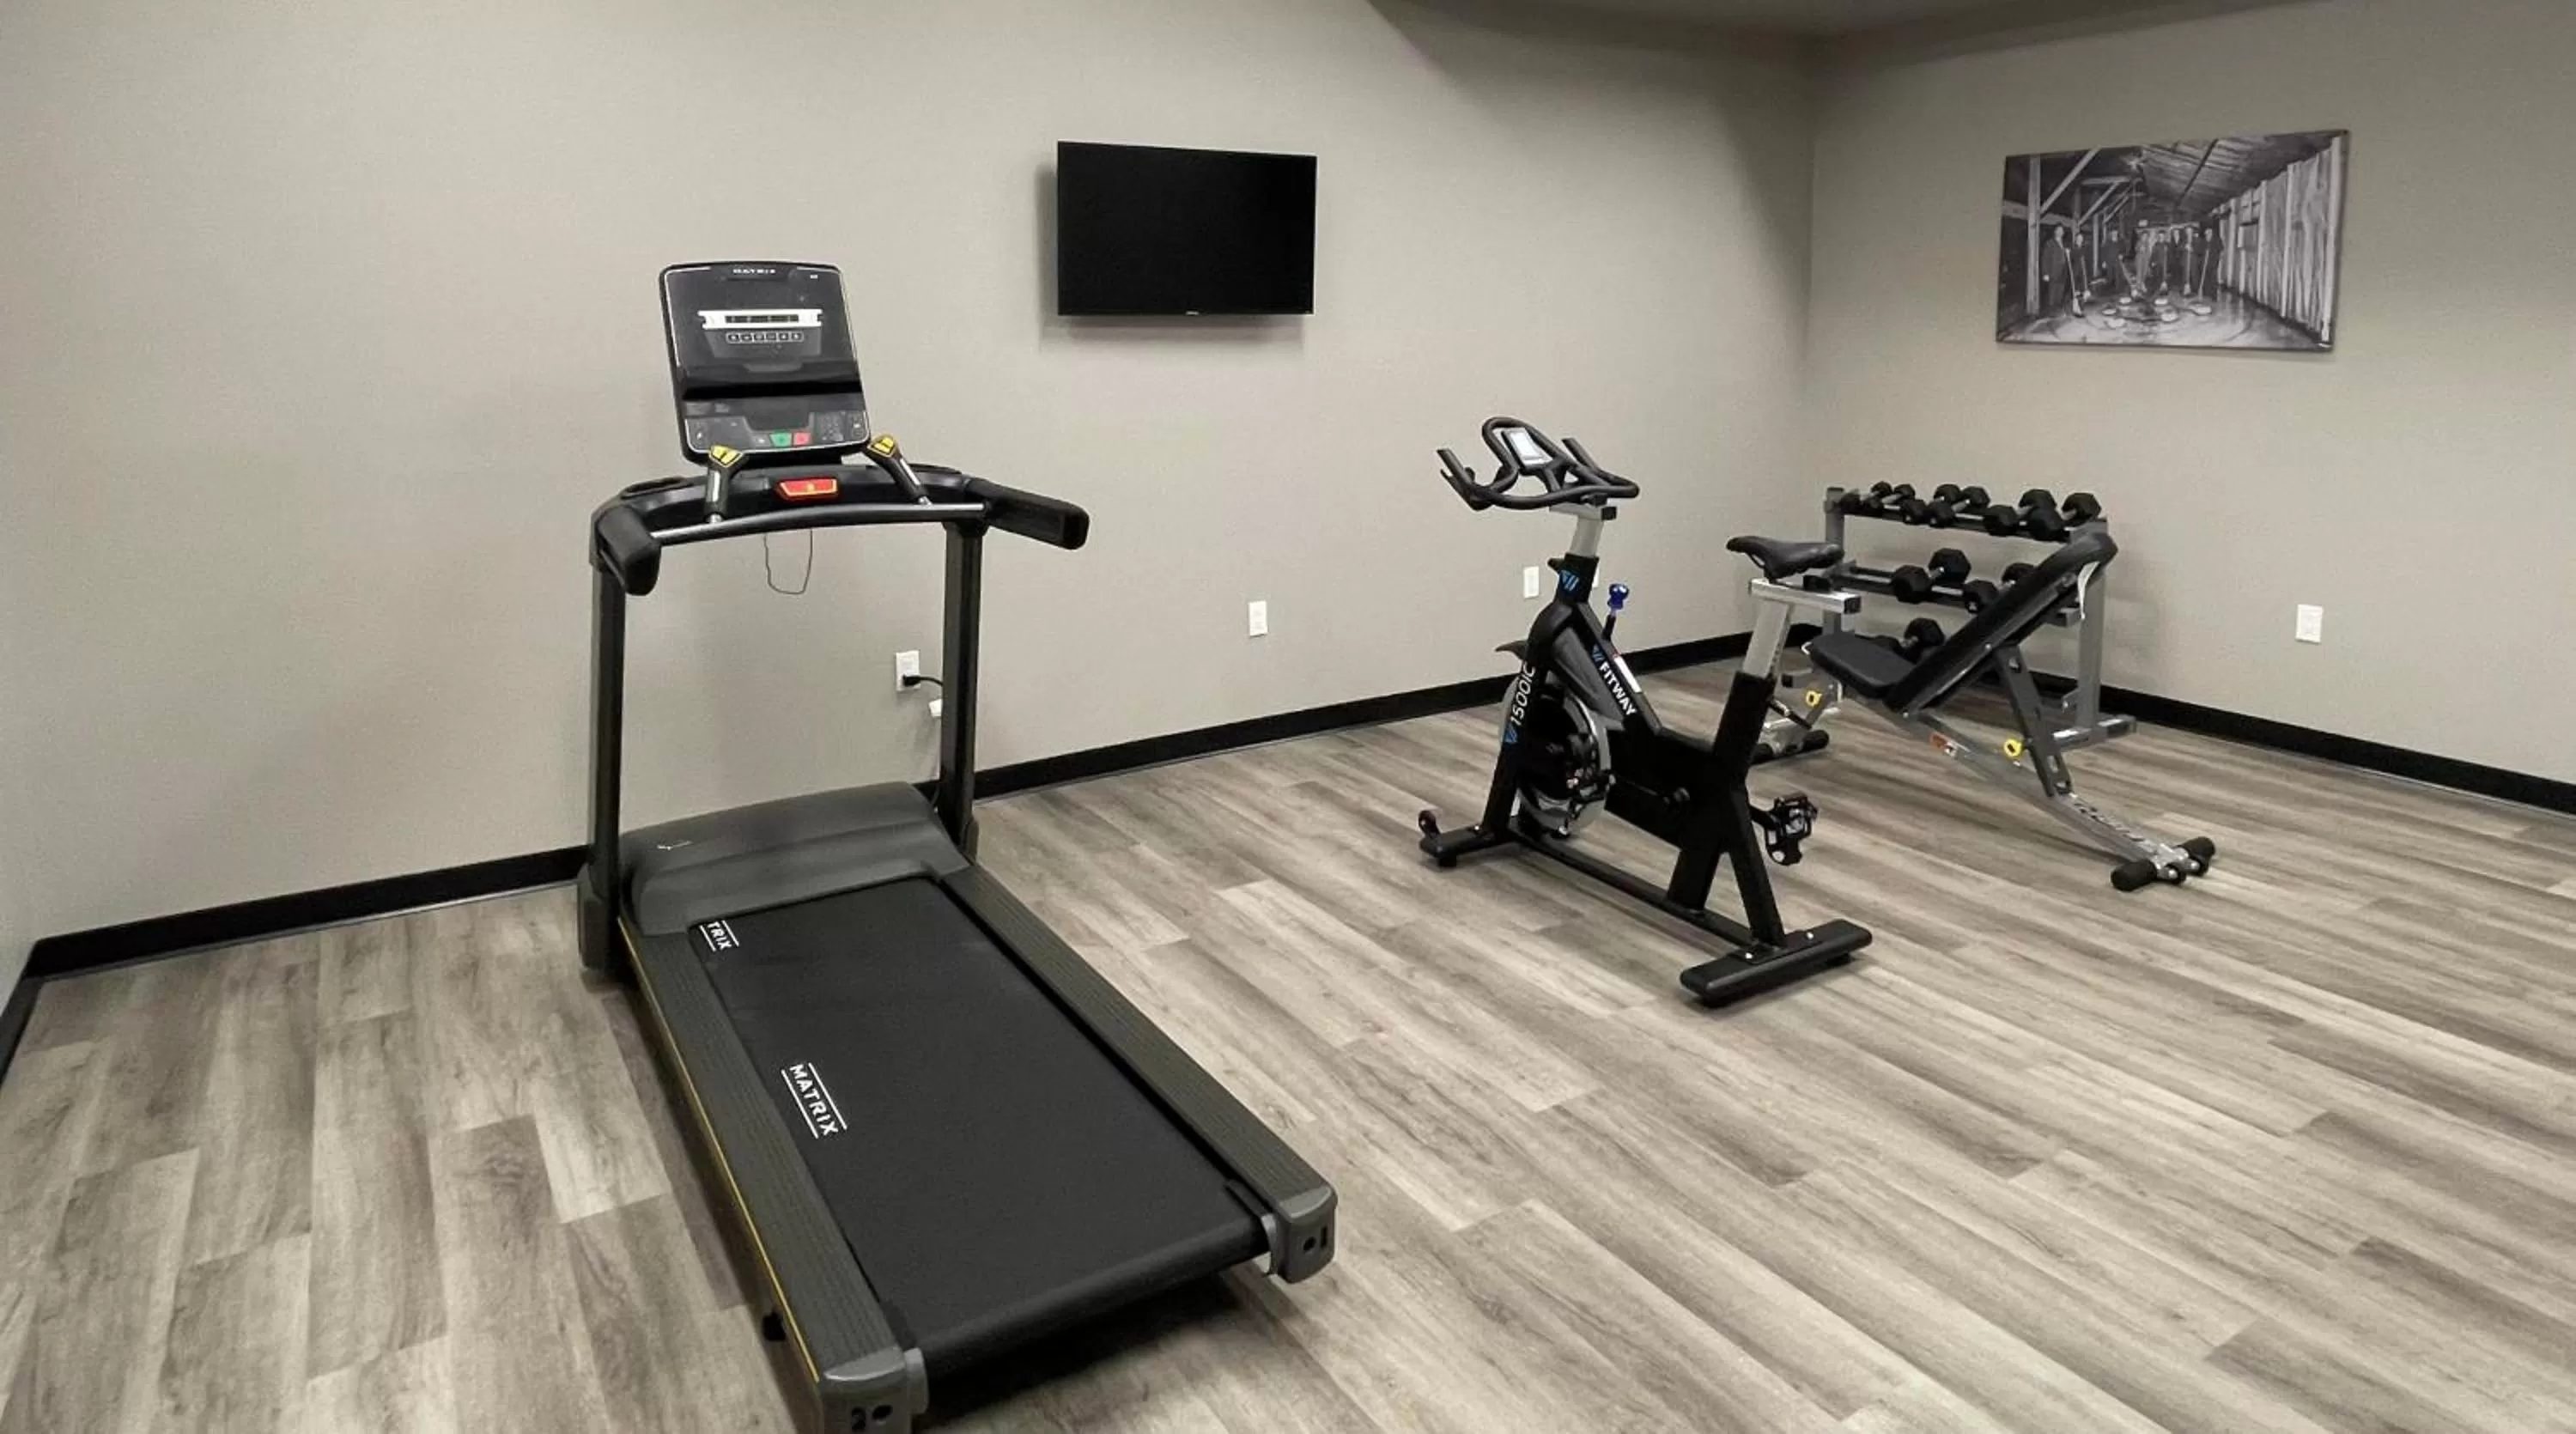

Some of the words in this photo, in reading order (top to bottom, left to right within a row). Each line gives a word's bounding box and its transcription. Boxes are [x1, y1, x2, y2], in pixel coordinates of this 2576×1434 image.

[1600, 660, 1637, 715] FITWAY
[707, 921, 732, 951] TRIX
[789, 1064, 839, 1135] MATRIX
